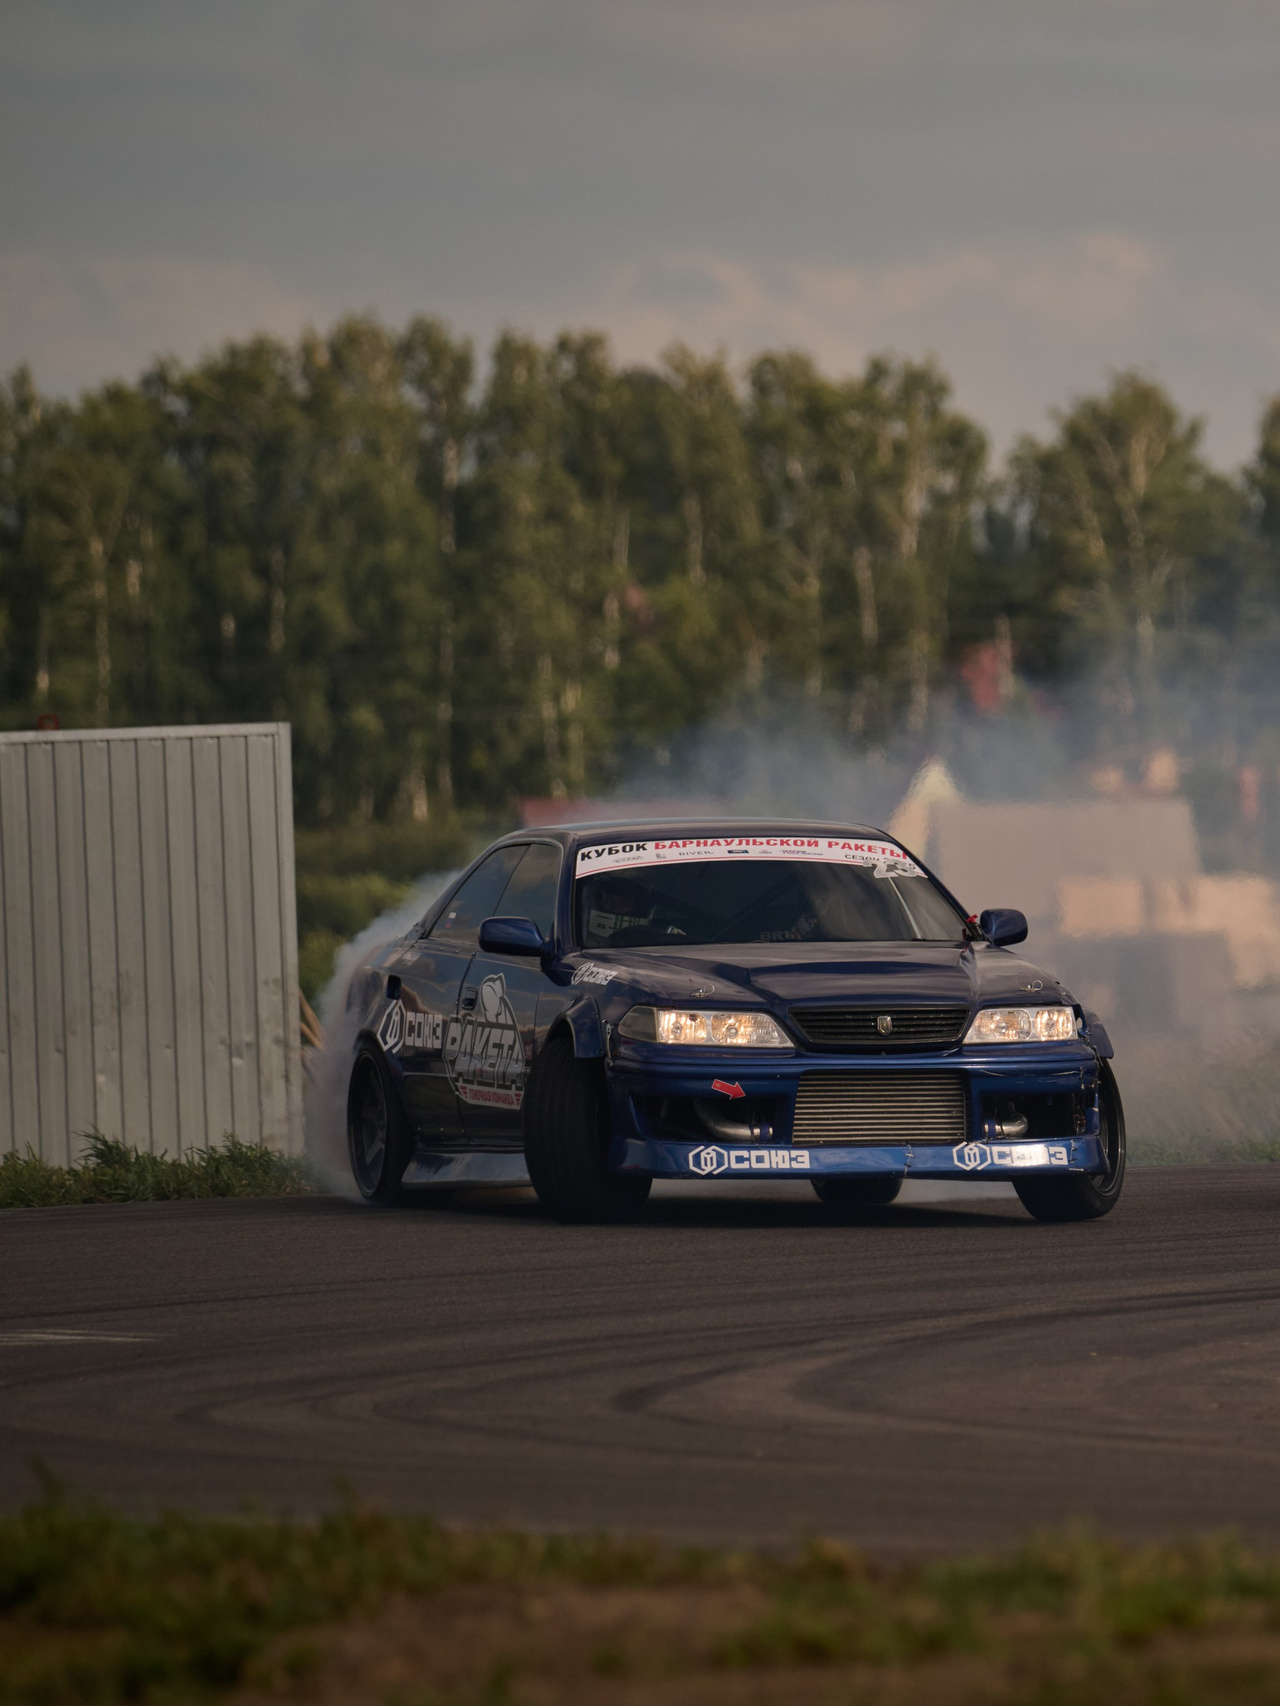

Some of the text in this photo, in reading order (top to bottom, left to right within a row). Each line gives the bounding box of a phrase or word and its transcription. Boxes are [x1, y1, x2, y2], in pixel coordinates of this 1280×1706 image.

[580, 843, 648, 862] КУБОК
[654, 838, 819, 850] БАРНАУЛЬСКОЙ
[827, 841, 908, 860] РАКЕТЫ
[862, 858, 919, 879] 23
[404, 1011, 443, 1049] СОЮЗ
[729, 1149, 811, 1169] СОЮЗ
